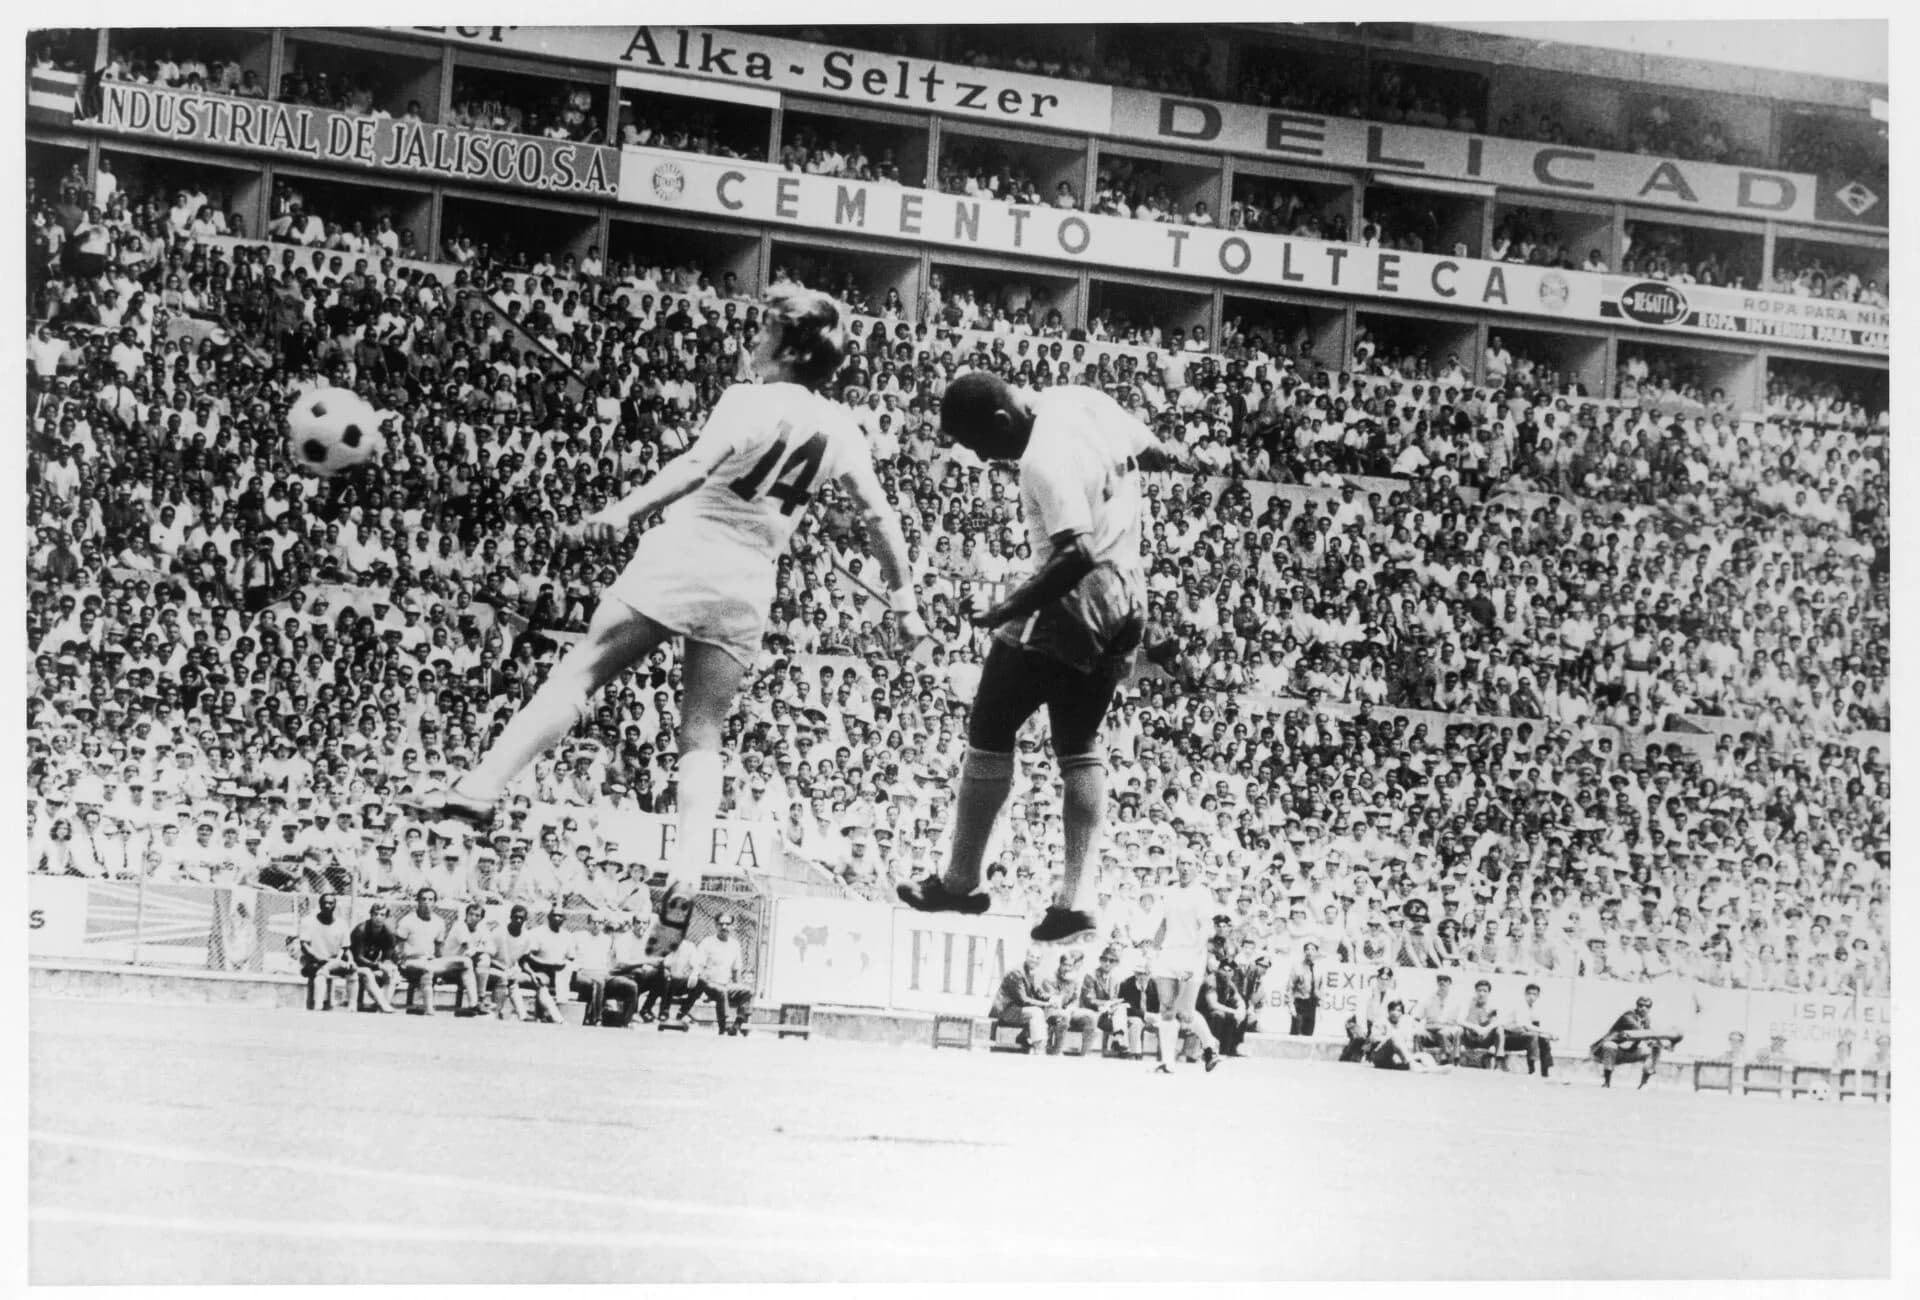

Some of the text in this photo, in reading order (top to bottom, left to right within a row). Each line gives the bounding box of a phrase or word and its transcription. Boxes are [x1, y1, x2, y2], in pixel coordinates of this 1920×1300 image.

[328, 116, 376, 162] DE
[1157, 97, 1797, 214] DELICAD
[716, 169, 1091, 255] CEMENTO
[1167, 229, 1509, 306] TOLTECA
[1698, 312, 1738, 331] ROPA
[1743, 298, 1798, 316] ROPA
[1804, 305, 1848, 322] PARA
[728, 422, 828, 517] 14
[658, 822, 760, 868] FFA
